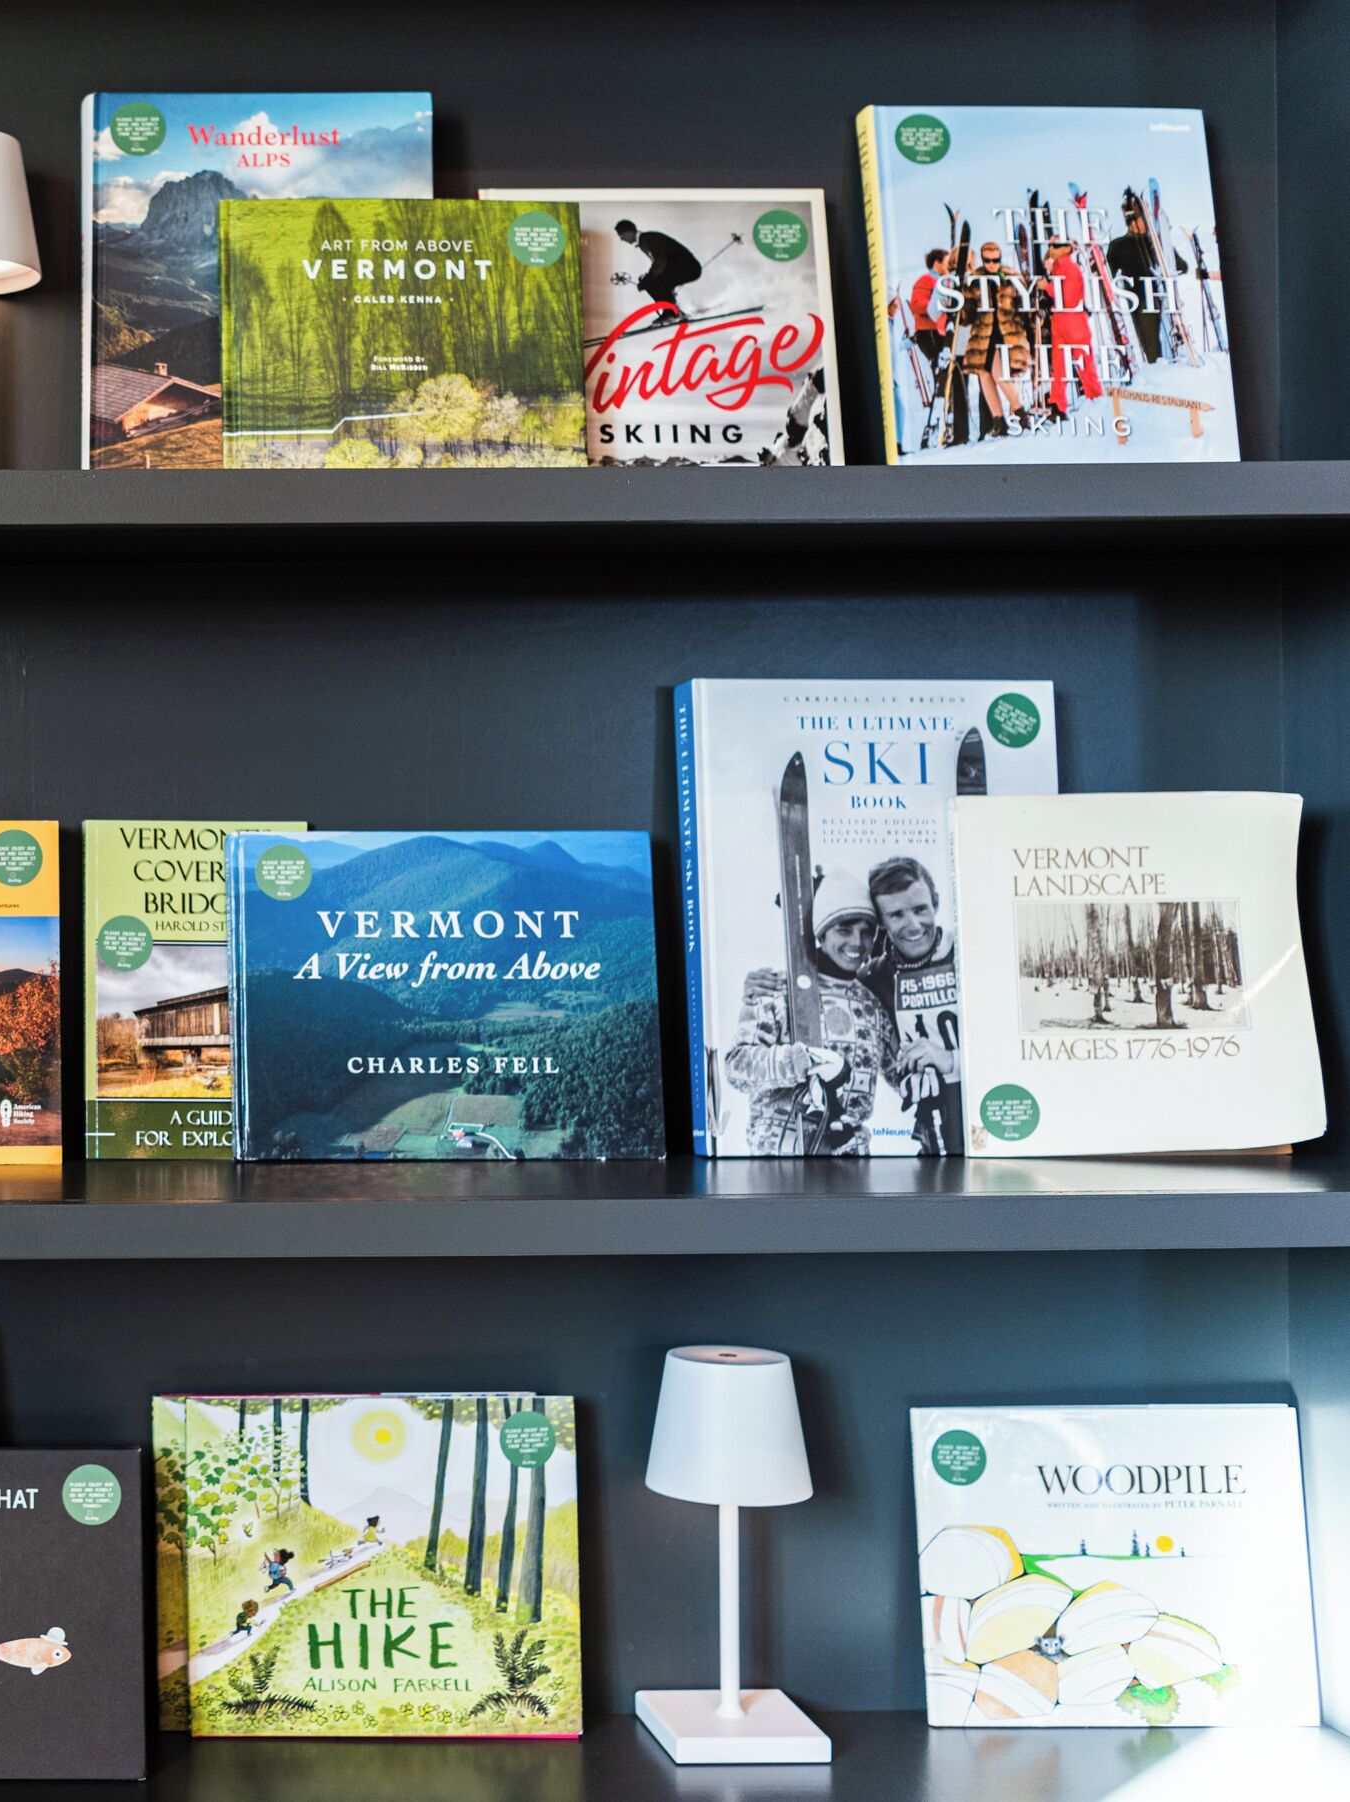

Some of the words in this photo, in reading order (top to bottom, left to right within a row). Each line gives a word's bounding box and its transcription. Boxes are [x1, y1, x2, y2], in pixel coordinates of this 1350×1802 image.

[186, 124, 341, 147] Wanderlust
[237, 153, 291, 168] ALPS
[992, 208, 1110, 245] THE
[321, 239, 353, 252] ART
[360, 239, 408, 252] FROM
[414, 239, 474, 252] ABOVE
[301, 259, 493, 281] VERMONT
[353, 295, 395, 304] CALEB
[400, 295, 442, 304] KENNA
[935, 274, 1181, 315] STYLISH
[995, 344, 1133, 384] LIFE
[600, 424, 743, 444] SKIING
[1006, 415, 1133, 437] SKIING
[796, 716, 839, 731] THE
[848, 716, 955, 731] ULTIMATE
[823, 741, 936, 785] SKI
[850, 795, 908, 810] BOOK
[1012, 846, 1150, 870] VERMONT
[1013, 873, 1166, 897] LANDSCAPE
[155, 921, 209, 931] HAROLD
[317, 911, 580, 938] VERMONT
[293, 953, 323, 980] A
[337, 953, 409, 980] View
[411, 951, 498, 988] from
[504, 951, 601, 980] Above
[1020, 1037, 1119, 1061] IMAGES
[1126, 1035, 1241, 1060] 1776-1976
[347, 1057, 480, 1074] CHARLES
[495, 1057, 560, 1074] FEIL
[13, 1110, 33, 1118] Hiking
[170, 1110, 182, 1125] A
[186, 1110, 232, 1125] GUID
[135, 1131, 171, 1146] FOR
[872, 1128, 912, 1137] teNeues
[1034, 1464, 1248, 1496] WOODPILE
[1164, 1500, 1196, 1509] PETER
[342, 1586, 421, 1620] THE
[307, 1621, 458, 1670] HIKE
[302, 1676, 377, 1692] ALISON
[394, 1676, 473, 1693] FARRELL
